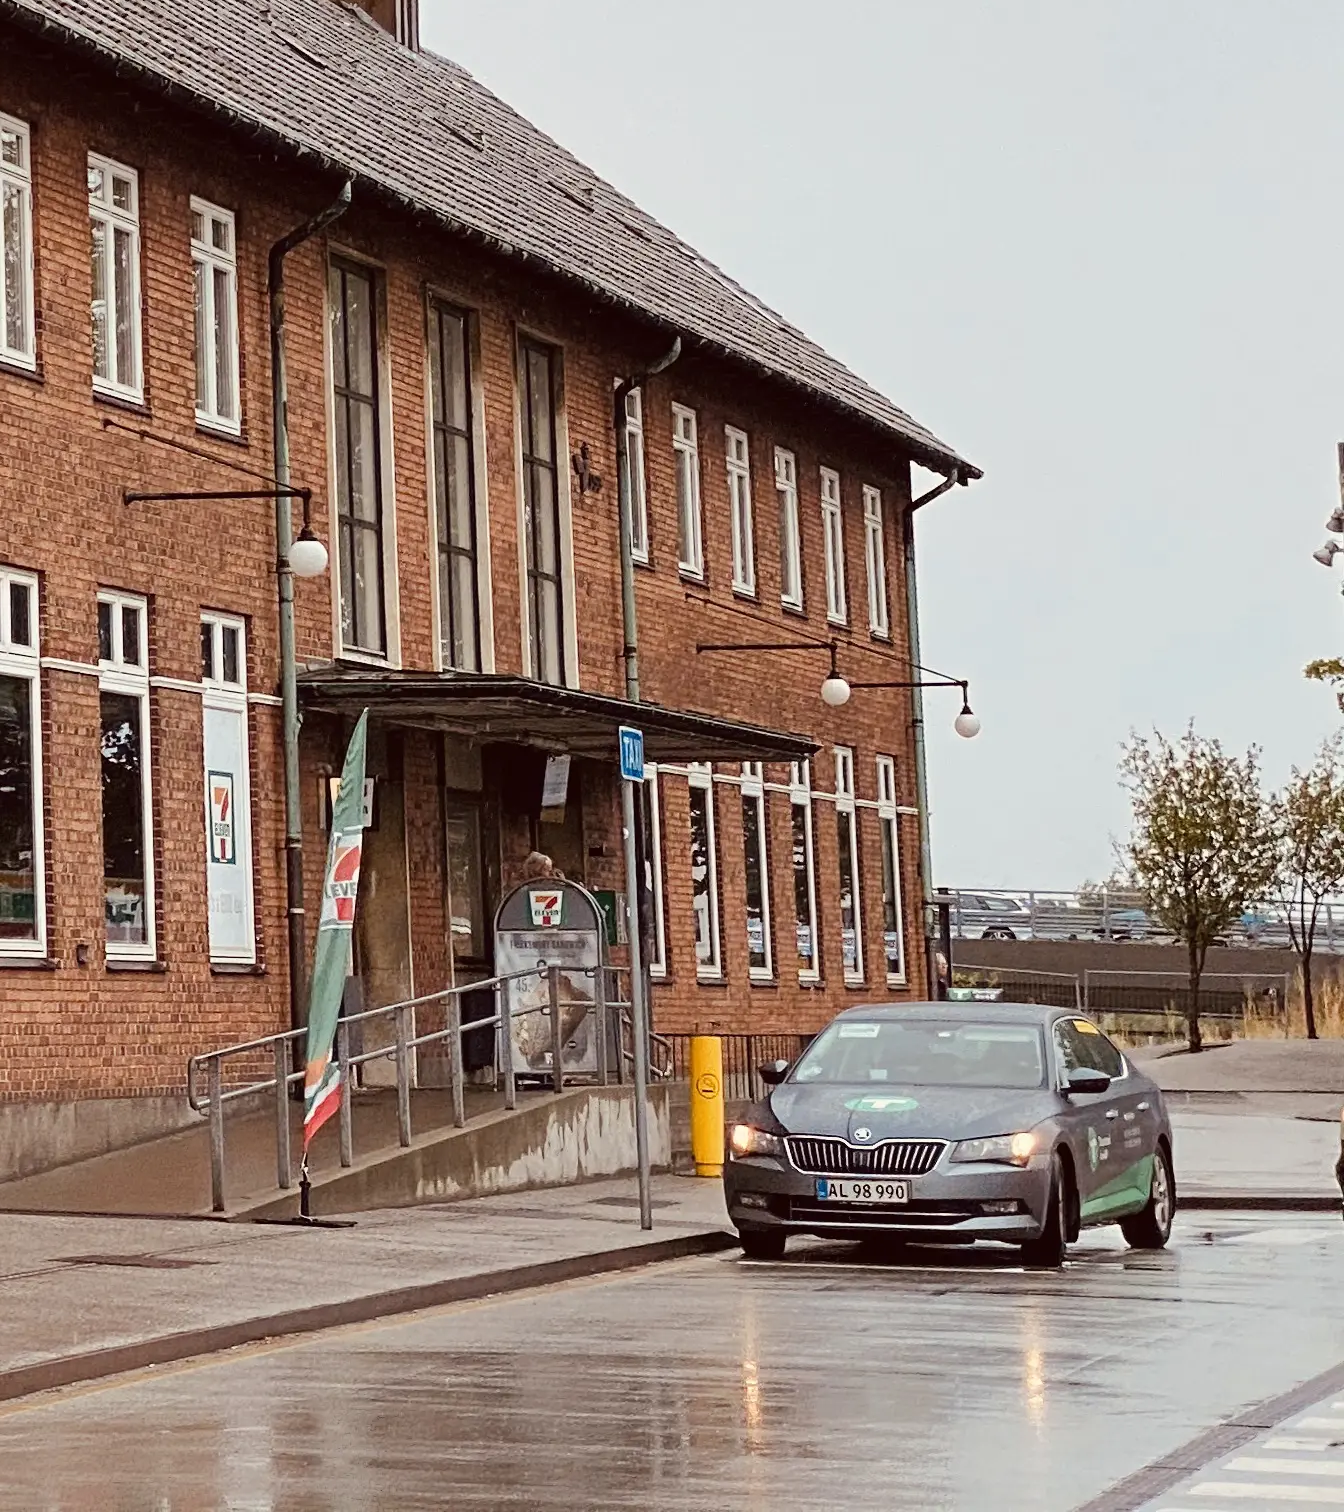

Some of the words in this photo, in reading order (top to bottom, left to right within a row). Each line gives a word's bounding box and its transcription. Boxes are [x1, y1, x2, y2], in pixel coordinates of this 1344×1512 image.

[829, 1183, 848, 1198] AL
[853, 1183, 872, 1199] 98
[875, 1184, 905, 1199] 990
